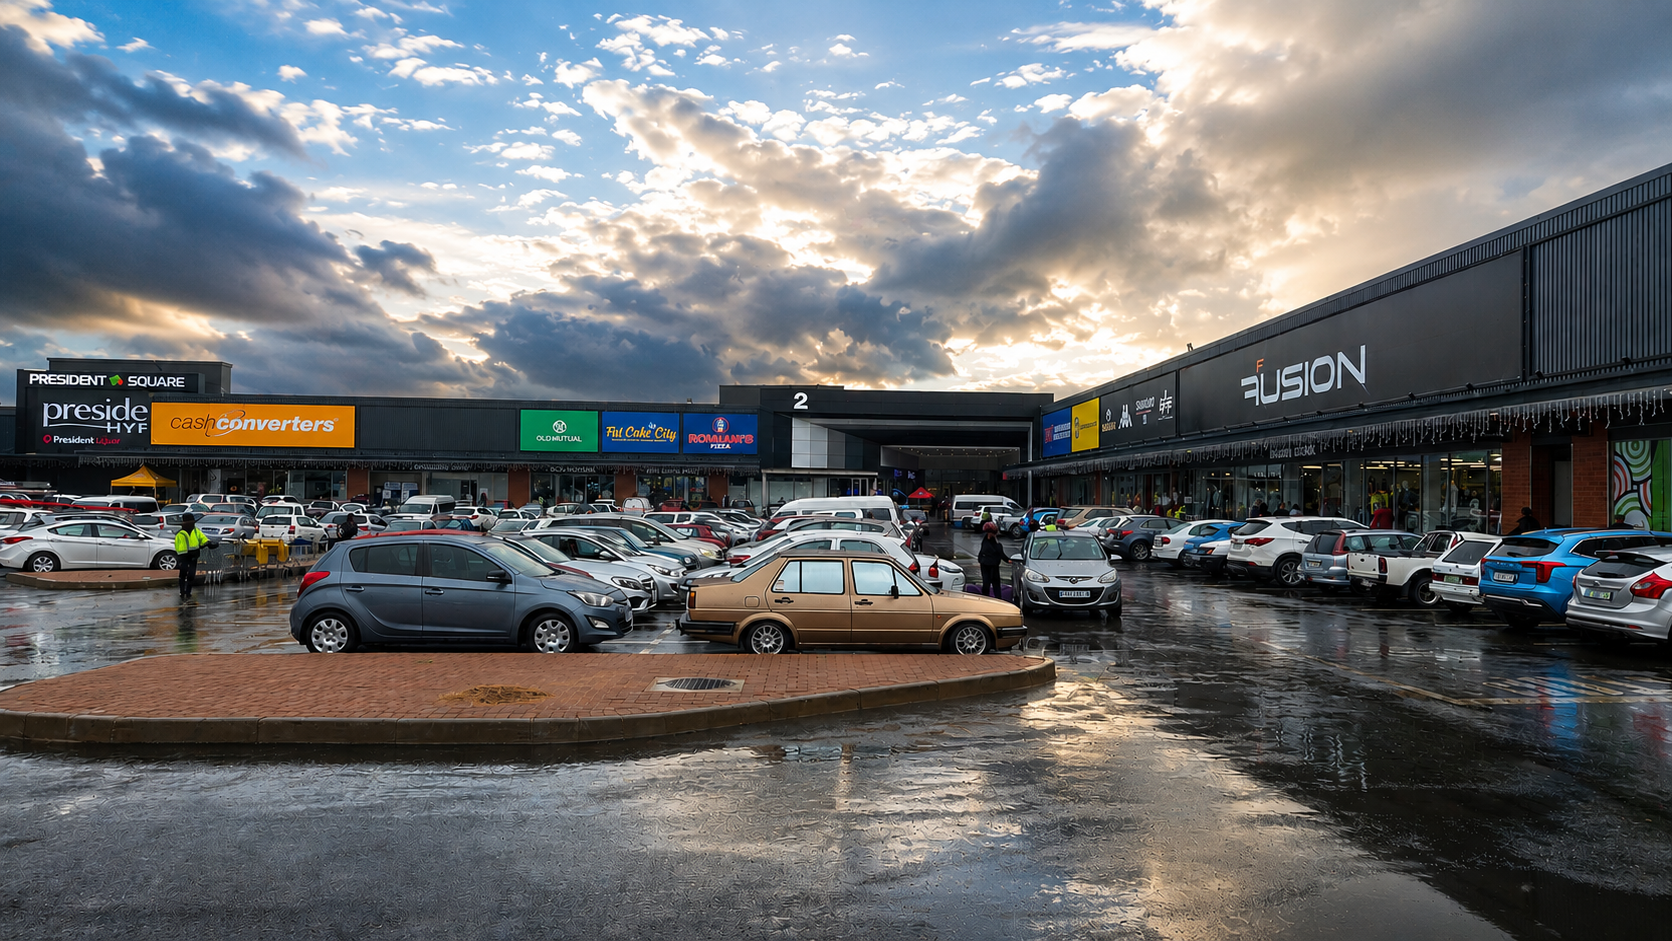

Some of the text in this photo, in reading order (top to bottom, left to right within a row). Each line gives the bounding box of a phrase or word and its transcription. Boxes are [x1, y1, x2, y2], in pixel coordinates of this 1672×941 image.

[29, 373, 185, 388] PRESIDENT SQUARE
[793, 392, 809, 410] 2
[625, 425, 652, 438] Cake
[53, 435, 94, 444] President
